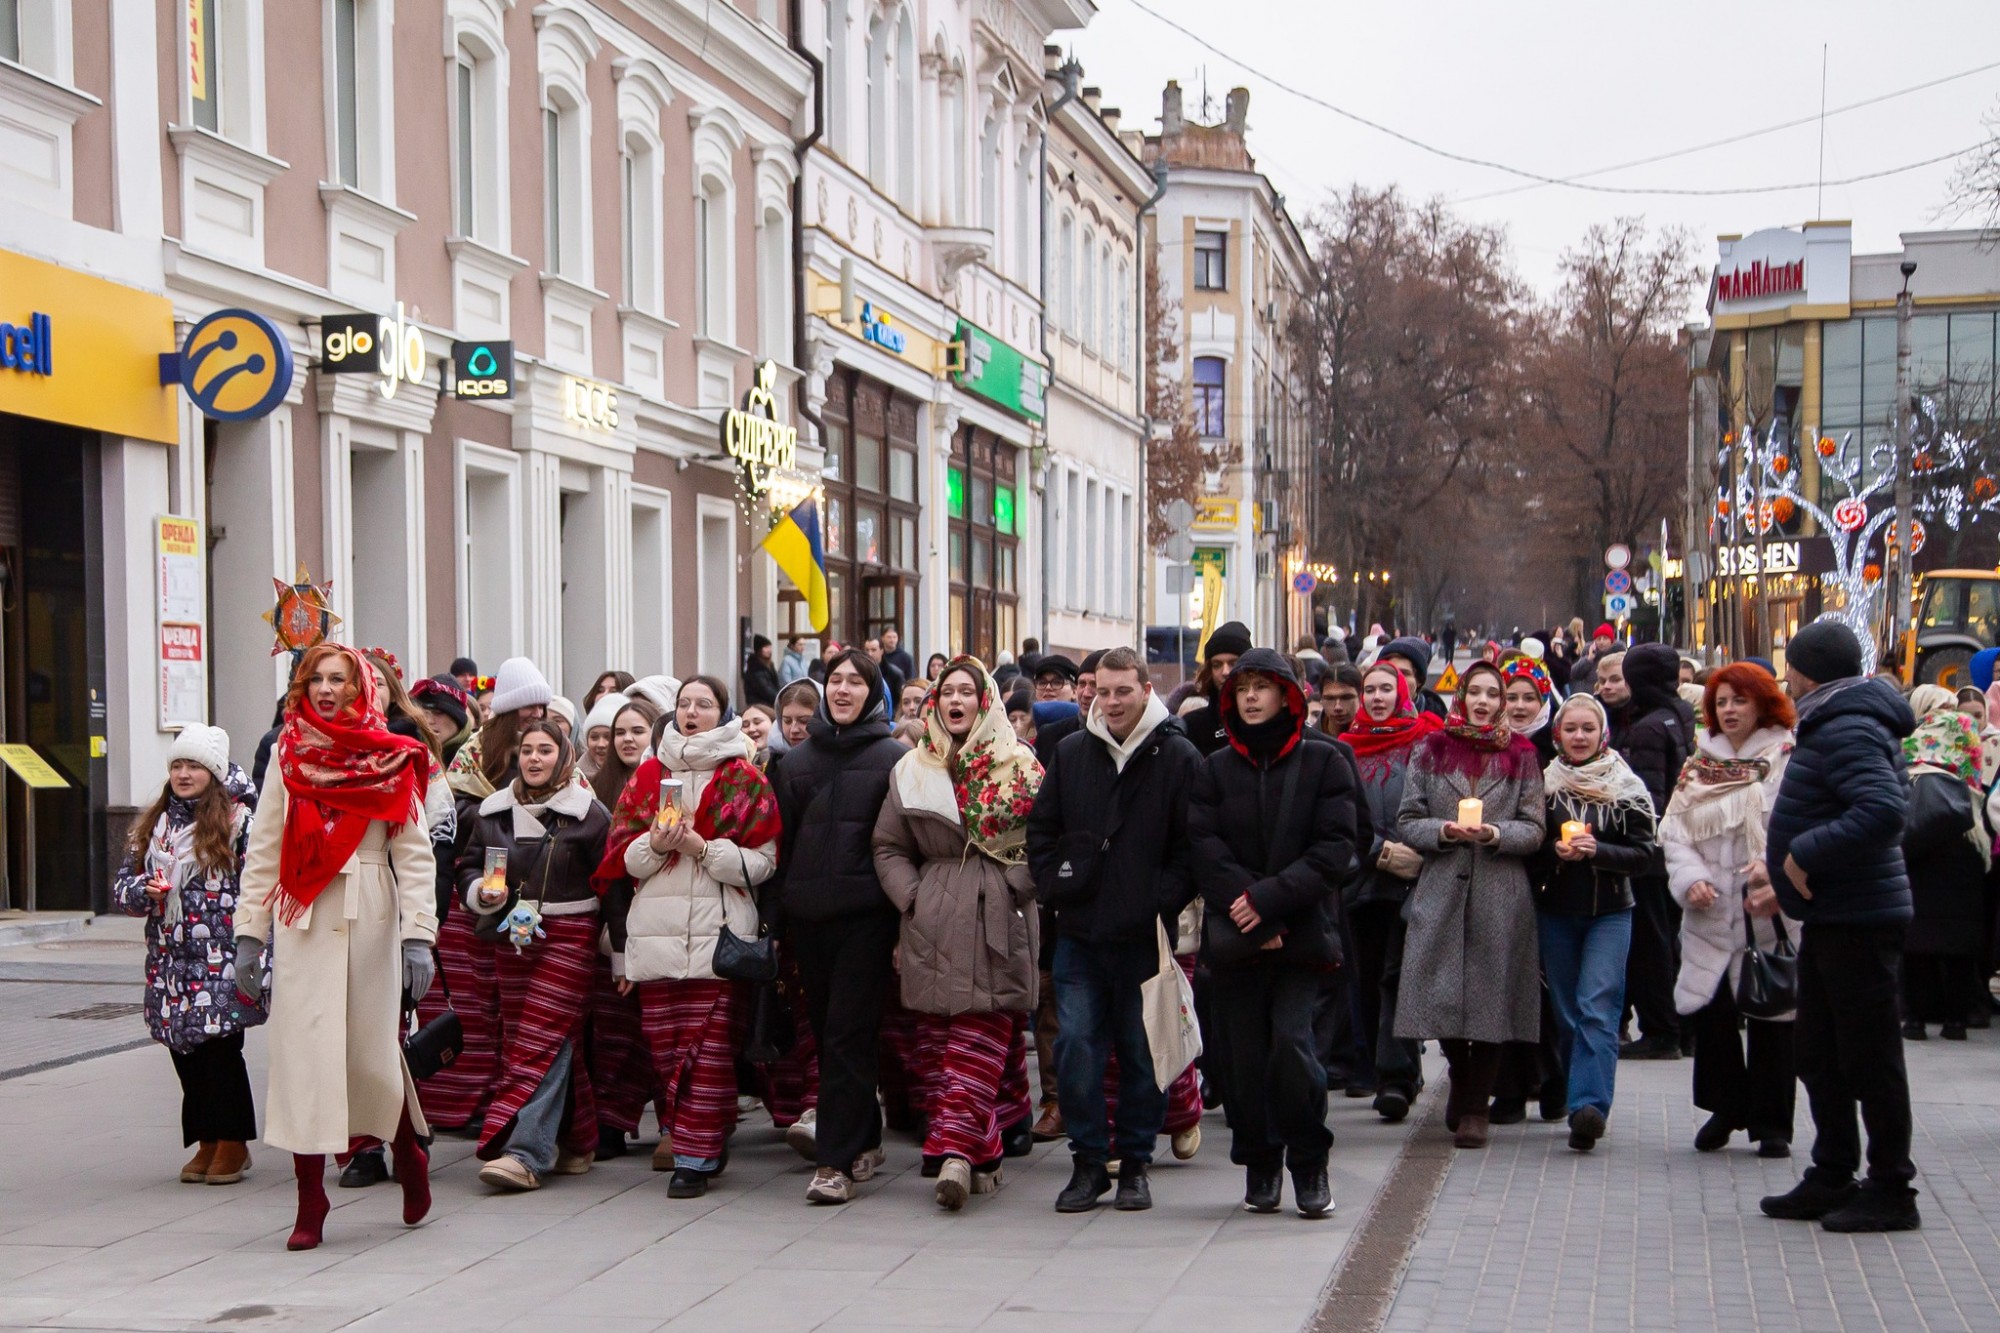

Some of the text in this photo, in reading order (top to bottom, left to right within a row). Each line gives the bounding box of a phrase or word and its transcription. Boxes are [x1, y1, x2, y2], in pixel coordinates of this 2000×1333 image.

[1718, 255, 1804, 301] MANHATTAN
[326, 325, 373, 362] glo
[379, 301, 425, 400] glo
[457, 380, 508, 396] IQOS
[565, 376, 619, 431] IQOS
[726, 408, 797, 472] СІДРЕРІЯ
